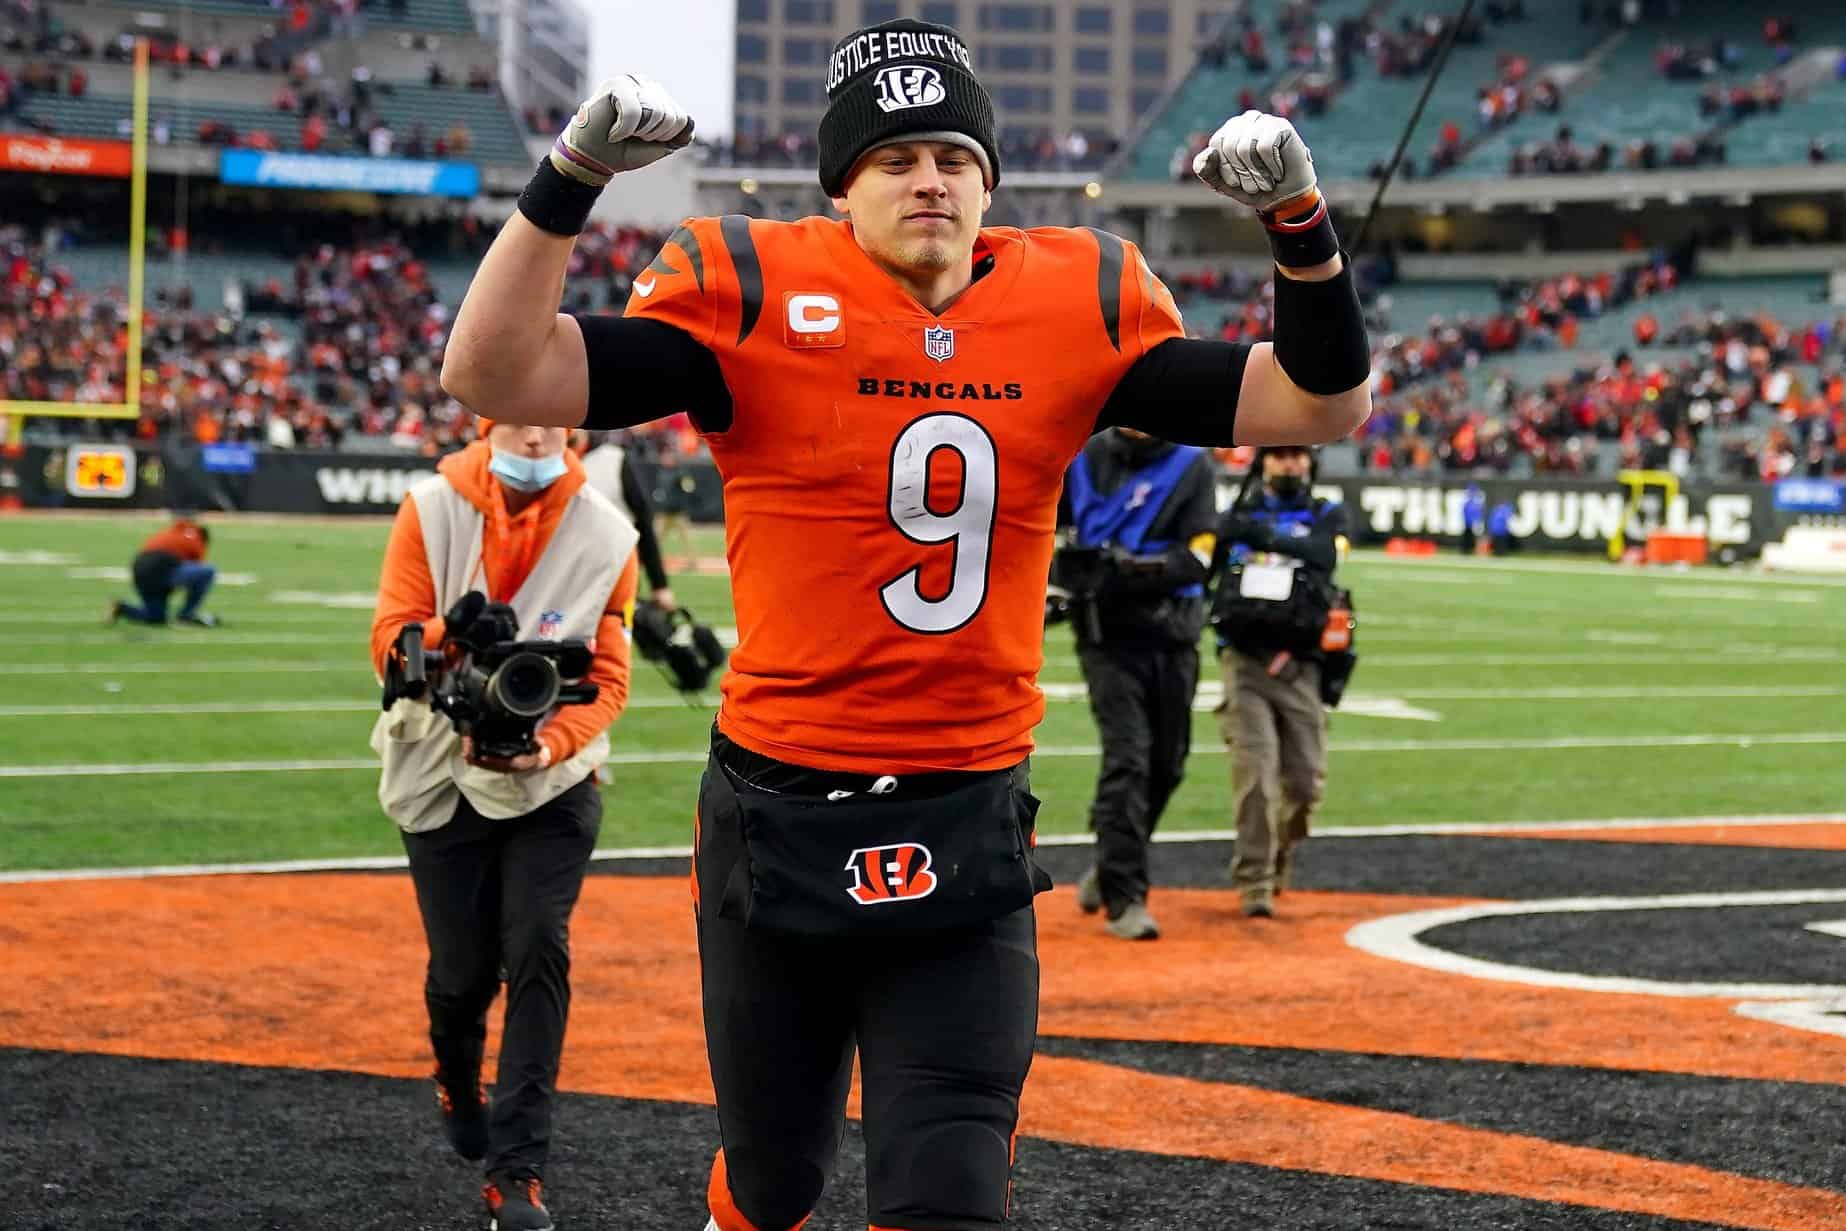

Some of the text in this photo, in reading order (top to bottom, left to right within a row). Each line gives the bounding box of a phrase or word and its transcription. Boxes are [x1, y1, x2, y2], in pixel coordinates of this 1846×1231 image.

[826, 32, 881, 94] JUSTICE
[886, 32, 959, 63] EQUITY
[788, 295, 840, 333] C
[857, 378, 1023, 400] BENGALS
[878, 411, 999, 635] 9
